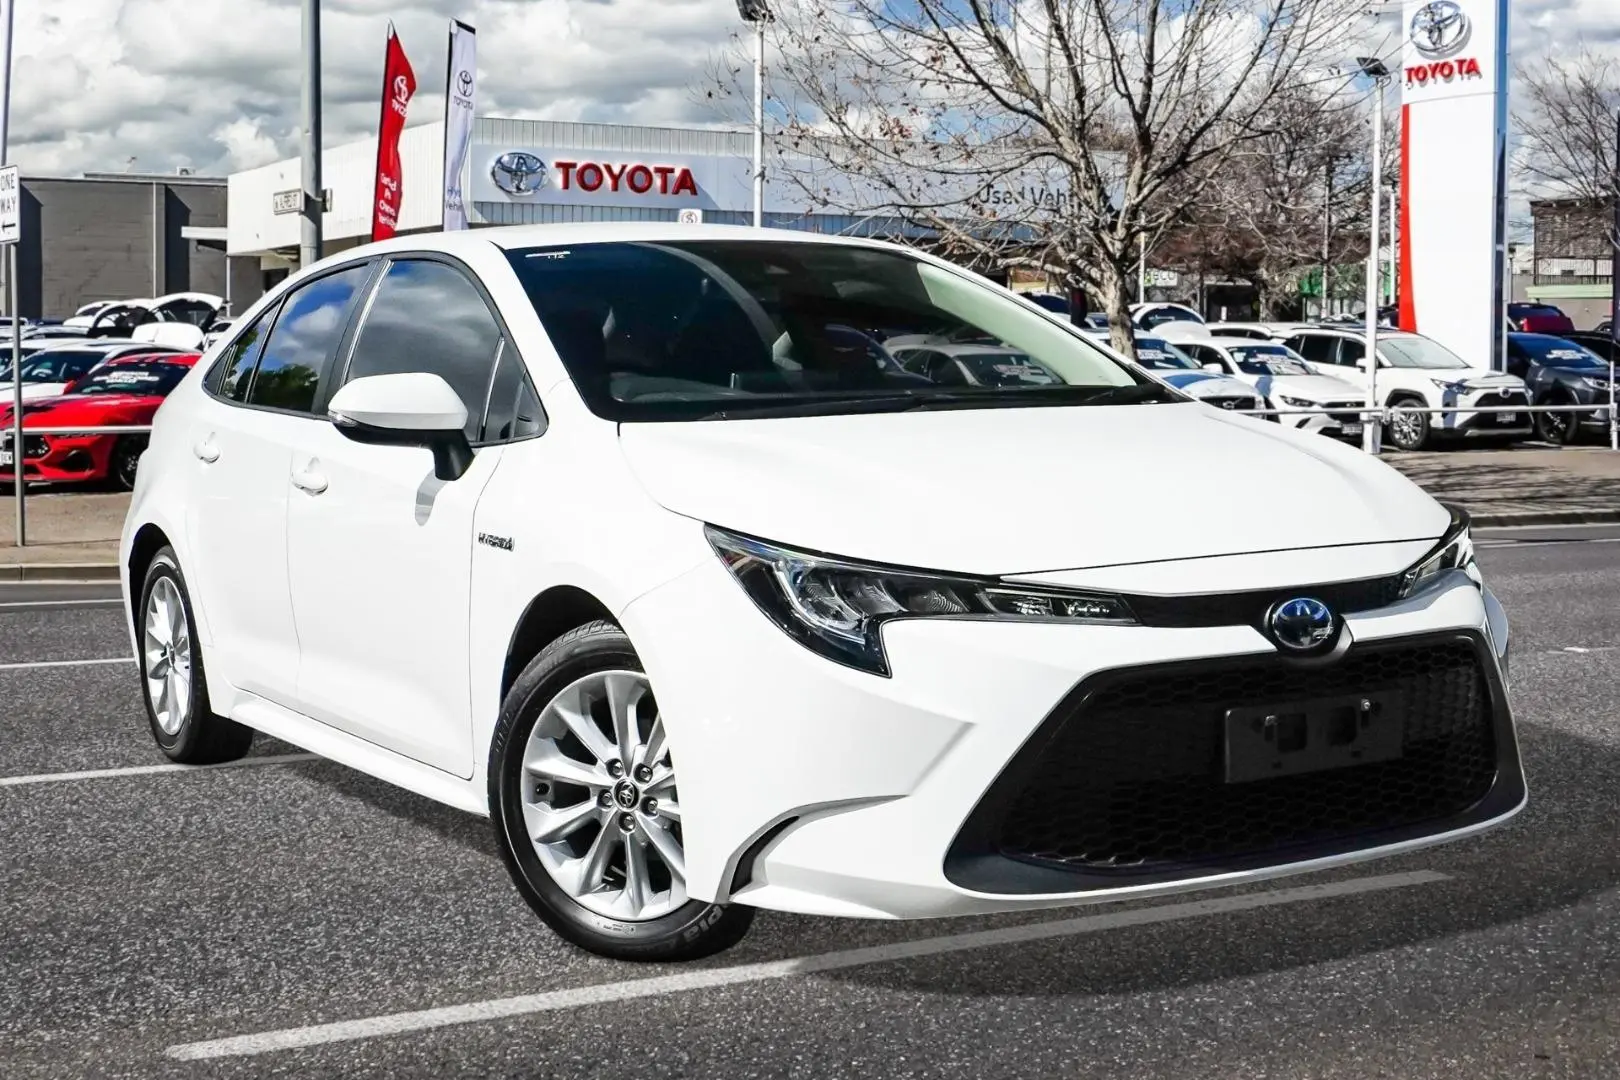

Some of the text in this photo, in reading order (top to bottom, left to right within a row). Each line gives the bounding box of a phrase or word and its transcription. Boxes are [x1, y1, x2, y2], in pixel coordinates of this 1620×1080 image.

[1404, 57, 1481, 83] TOYOTA
[1, 173, 15, 192] ONE
[554, 161, 698, 196] TOYOTA
[1, 195, 16, 215] WAY
